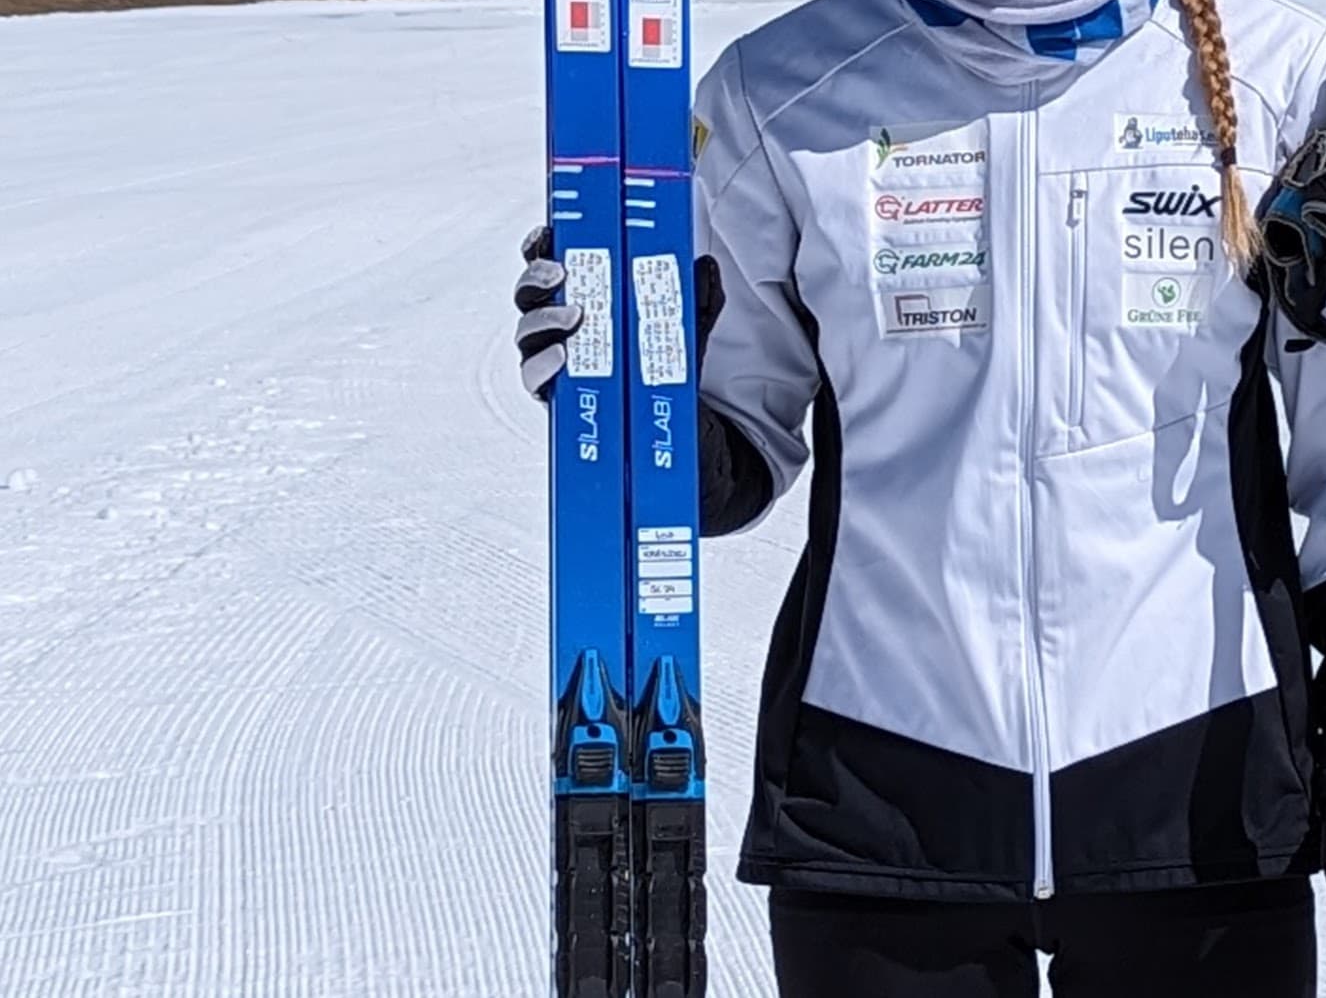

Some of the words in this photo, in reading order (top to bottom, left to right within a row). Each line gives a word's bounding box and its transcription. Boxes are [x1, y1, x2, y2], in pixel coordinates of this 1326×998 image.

[893, 150, 986, 168] TORNATOR
[904, 197, 984, 216] LATTER
[1124, 227, 1214, 262] silen
[901, 251, 986, 270] FARM24
[903, 308, 977, 327] TRISTON
